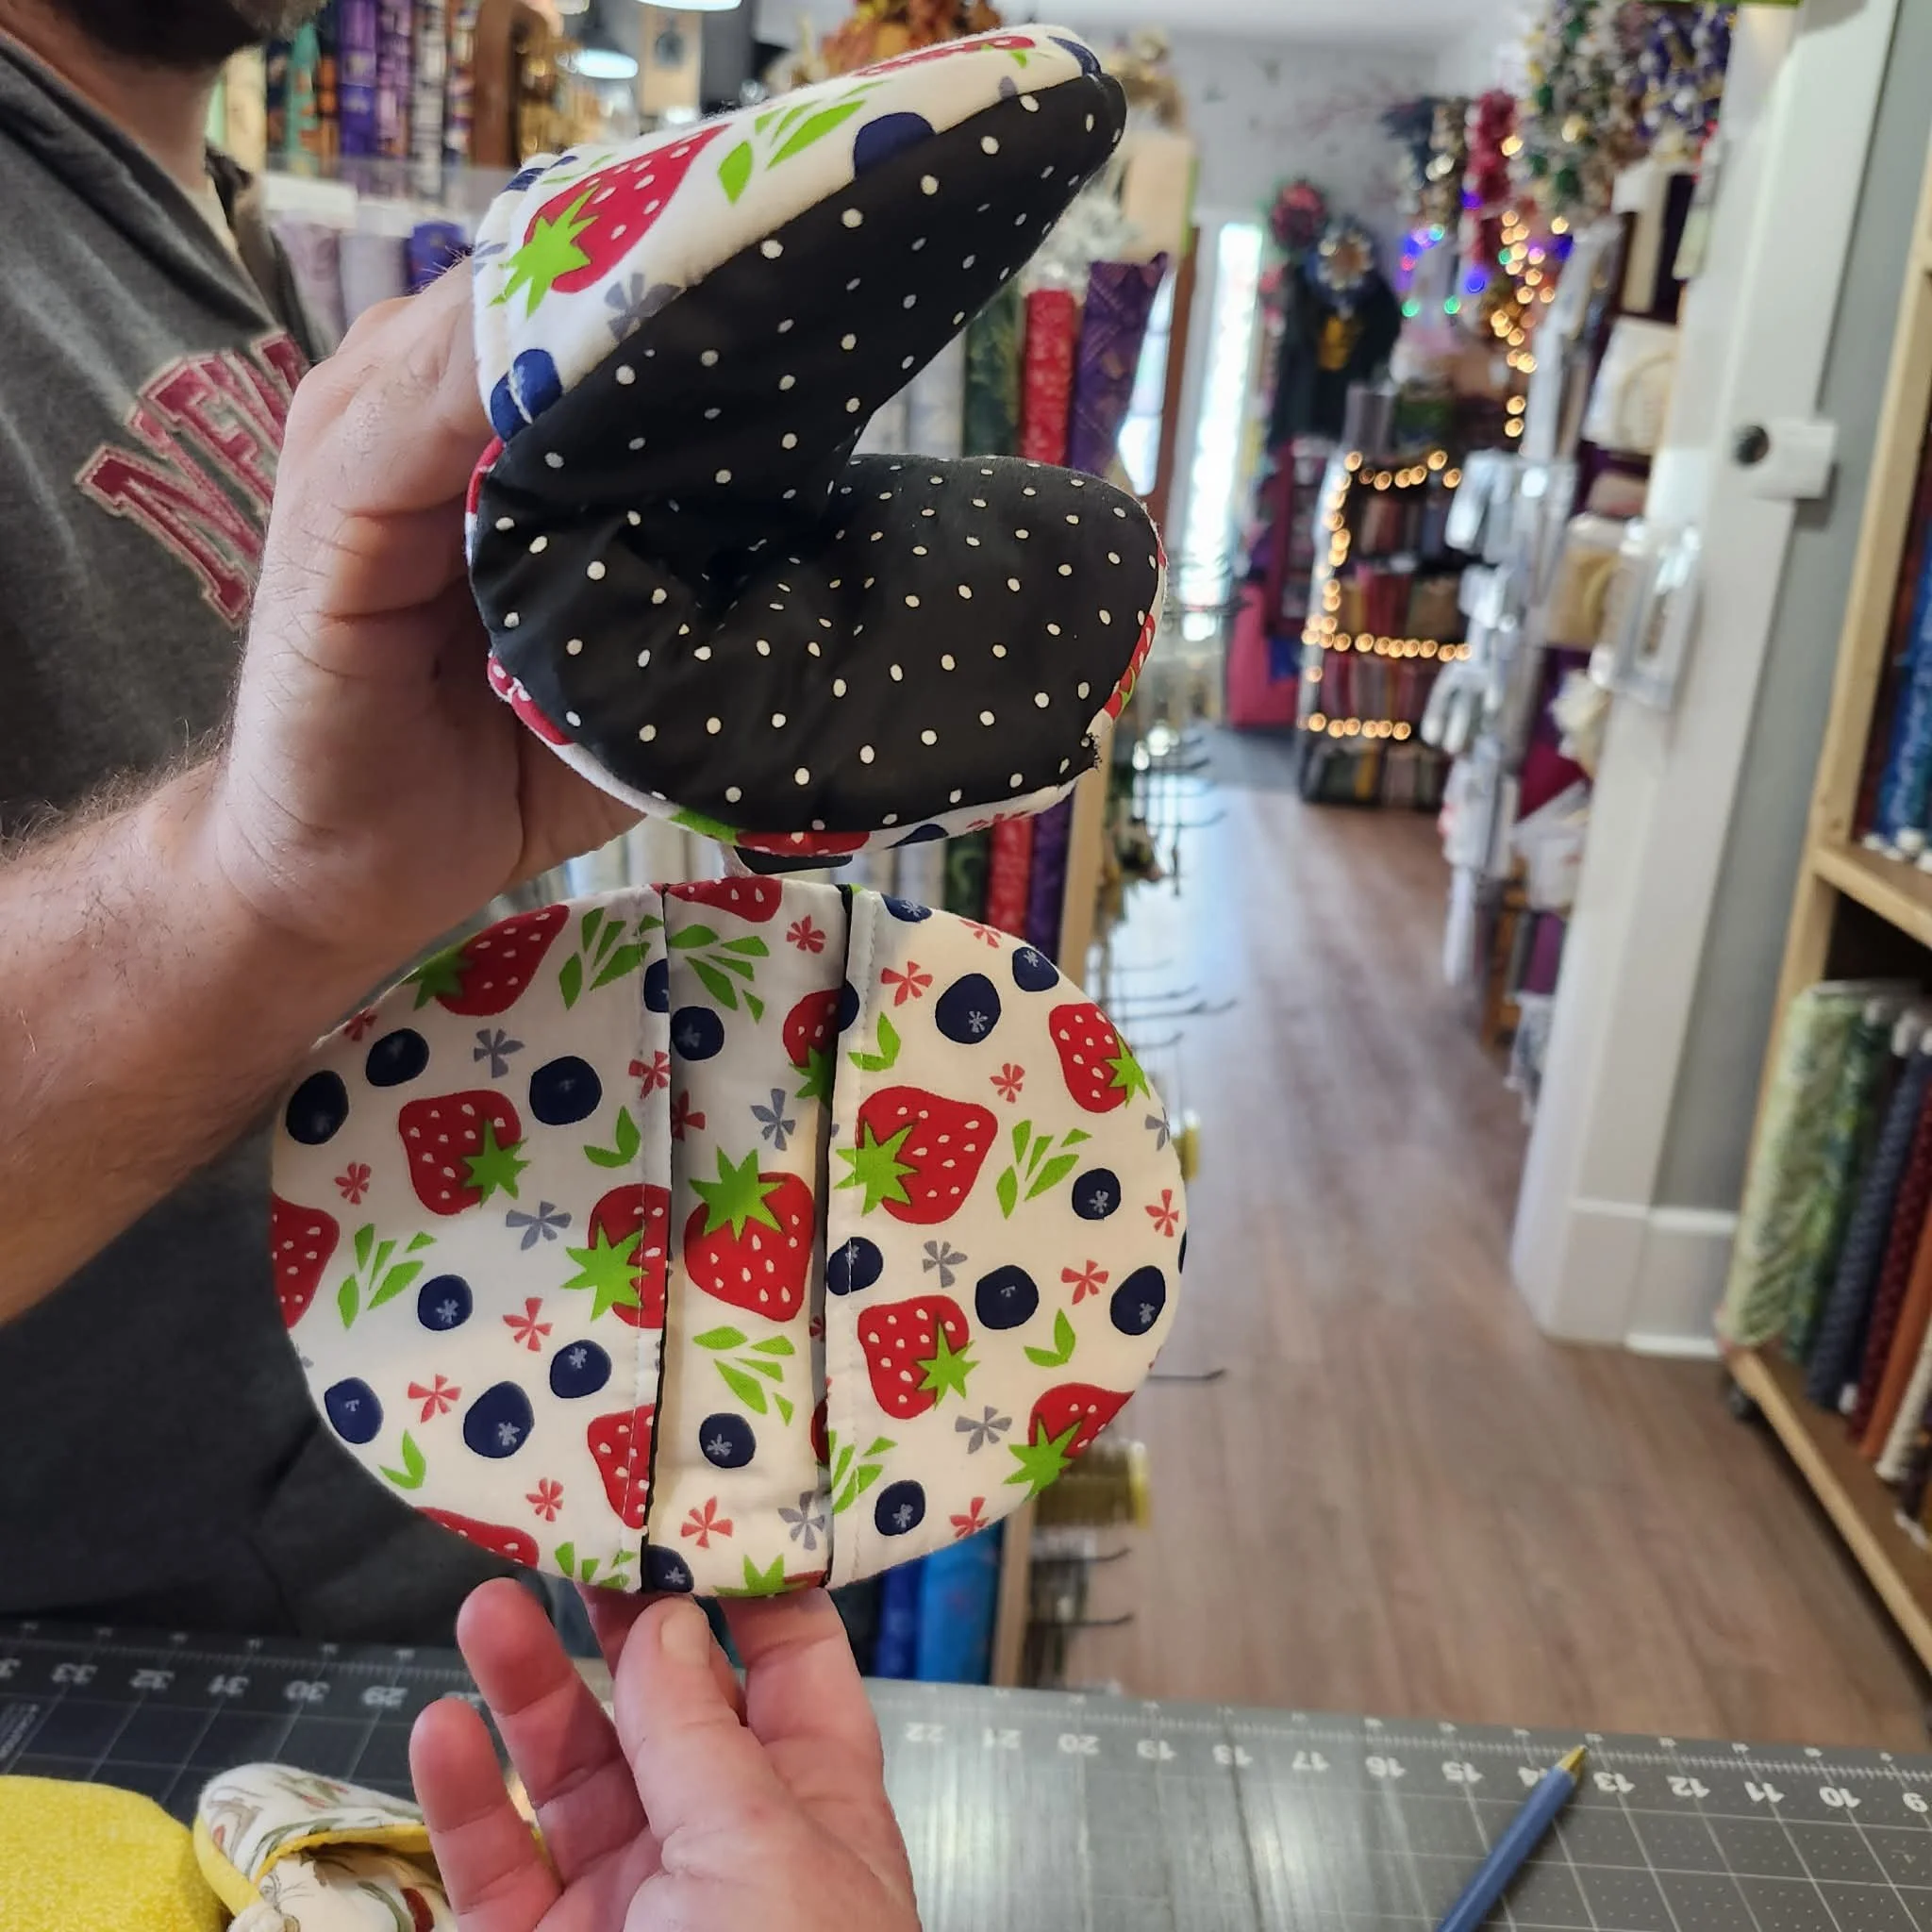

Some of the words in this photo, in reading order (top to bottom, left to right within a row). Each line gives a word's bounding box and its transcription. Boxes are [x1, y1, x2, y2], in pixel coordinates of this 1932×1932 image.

[0, 1657, 22, 1679] 3
[50, 1663, 98, 1685] 33
[128, 1668, 175, 1690] 32
[206, 1674, 249, 1697] 31
[283, 1680, 330, 1702] 30
[360, 1686, 408, 1707] 29
[905, 1722, 946, 1743] 22
[981, 1727, 1023, 1750] 21
[1058, 1732, 1101, 1755] 20
[1136, 1739, 1177, 1761] 19
[1212, 1744, 1253, 1767] 18
[1291, 1751, 1330, 1772] 17
[1365, 1756, 1407, 1778] 16
[1441, 1760, 1484, 1783] 15
[1592, 1772, 1636, 1793] 13
[1666, 1775, 1710, 1798] 12
[1744, 1781, 1785, 1803] 11
[1819, 1786, 1861, 1807] 10
